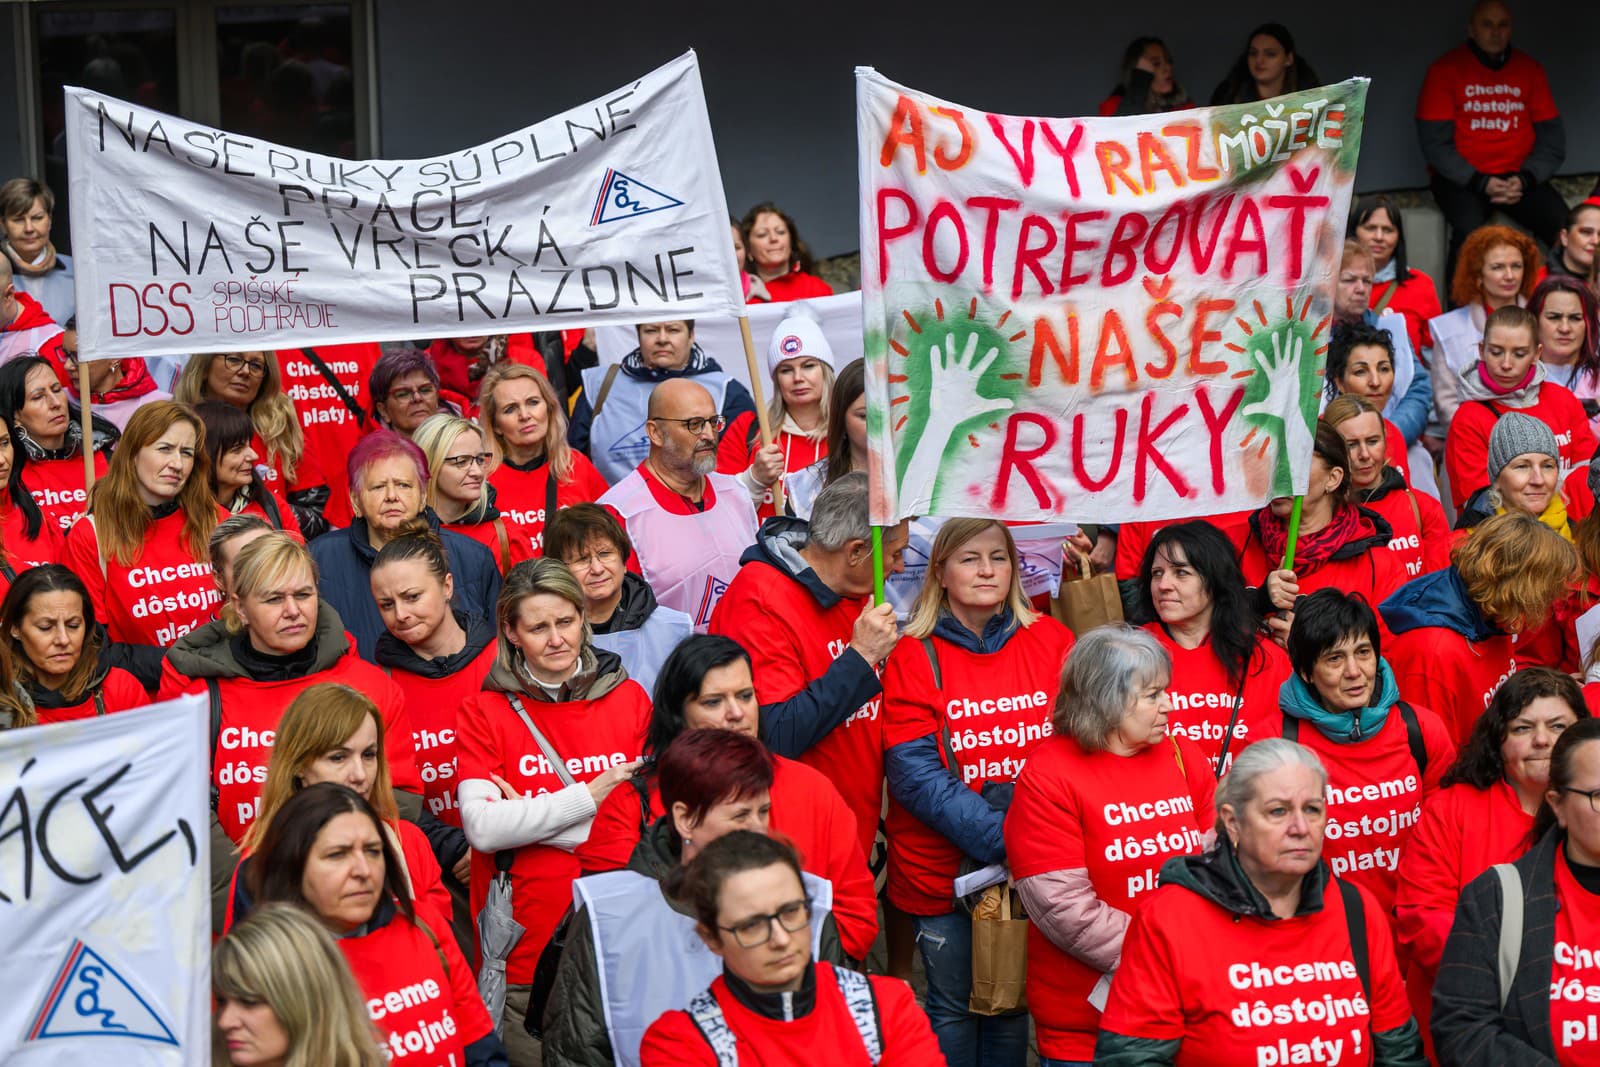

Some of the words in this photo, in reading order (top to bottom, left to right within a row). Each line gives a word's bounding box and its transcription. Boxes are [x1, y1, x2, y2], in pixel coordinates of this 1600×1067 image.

[97, 101, 255, 176] NAŠE
[268, 149, 404, 190] RUKY
[419, 150, 481, 188] SÚ
[491, 81, 642, 175] PLNÉ
[1471, 116, 1510, 132] platy
[1513, 115, 1519, 129] !
[880, 94, 975, 175] AJ
[986, 114, 1085, 199] VY
[1095, 124, 1221, 196] RAZ
[1219, 99, 1346, 172] MÔŽETE
[149, 215, 309, 276] NAŠE
[331, 205, 569, 270] VRECKÁ
[877, 164, 1330, 300] POTREBOVAŤ
[212, 272, 302, 306] SPIŠSKÉ
[409, 247, 703, 324] PRÁZDNE
[109, 282, 195, 337] DSS
[215, 304, 339, 333] PODHRADIE
[1028, 275, 1236, 388] NAŠE
[286, 361, 359, 377] Chcme
[287, 380, 360, 401] dôstoné
[303, 406, 345, 427] platy
[993, 386, 1244, 510] RUKY
[31, 488, 87, 506] Chce
[128, 562, 213, 588] Chcem
[132, 587, 223, 618] dôstojn
[947, 691, 1047, 719] Chceme
[950, 717, 1054, 752] dôstojné
[519, 752, 627, 776] Cheme
[963, 756, 1026, 784] platy
[1325, 775, 1417, 806] hceme
[0, 757, 197, 903] ÁCE,
[1325, 802, 1421, 840] ôstojné
[1105, 826, 1200, 862] dôstojn
[1331, 846, 1400, 878] platy
[1228, 960, 1357, 990] Chceme
[366, 979, 441, 1020] ceme
[1231, 992, 1370, 1028] dôstojné
[1256, 1035, 1344, 1067] platy
[1350, 1029, 1362, 1055] !
